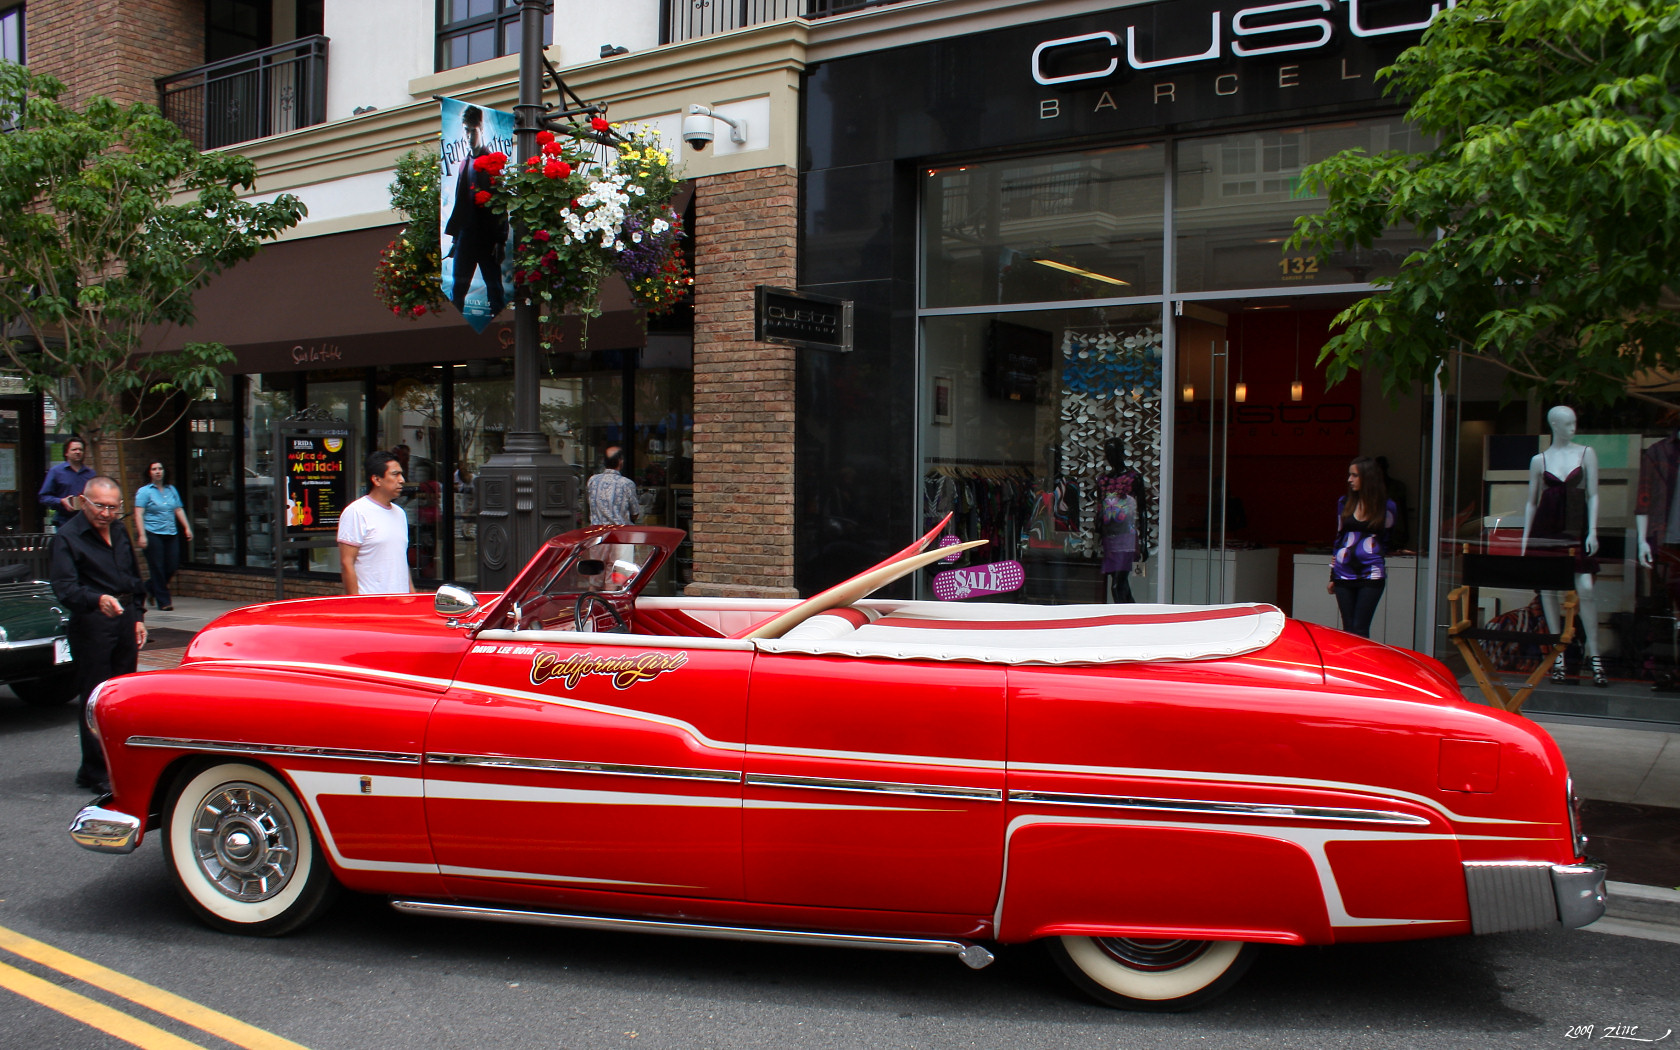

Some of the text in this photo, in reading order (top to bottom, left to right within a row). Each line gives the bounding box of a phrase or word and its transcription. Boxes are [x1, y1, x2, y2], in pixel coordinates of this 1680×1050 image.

[1040, 58, 1361, 119] BARCEL
[1278, 256, 1318, 274] 132
[317, 451, 327, 460] de
[954, 569, 1004, 592] SALE
[471, 645, 537, 655] DAVID LEE ROTH
[532, 651, 636, 688] California
